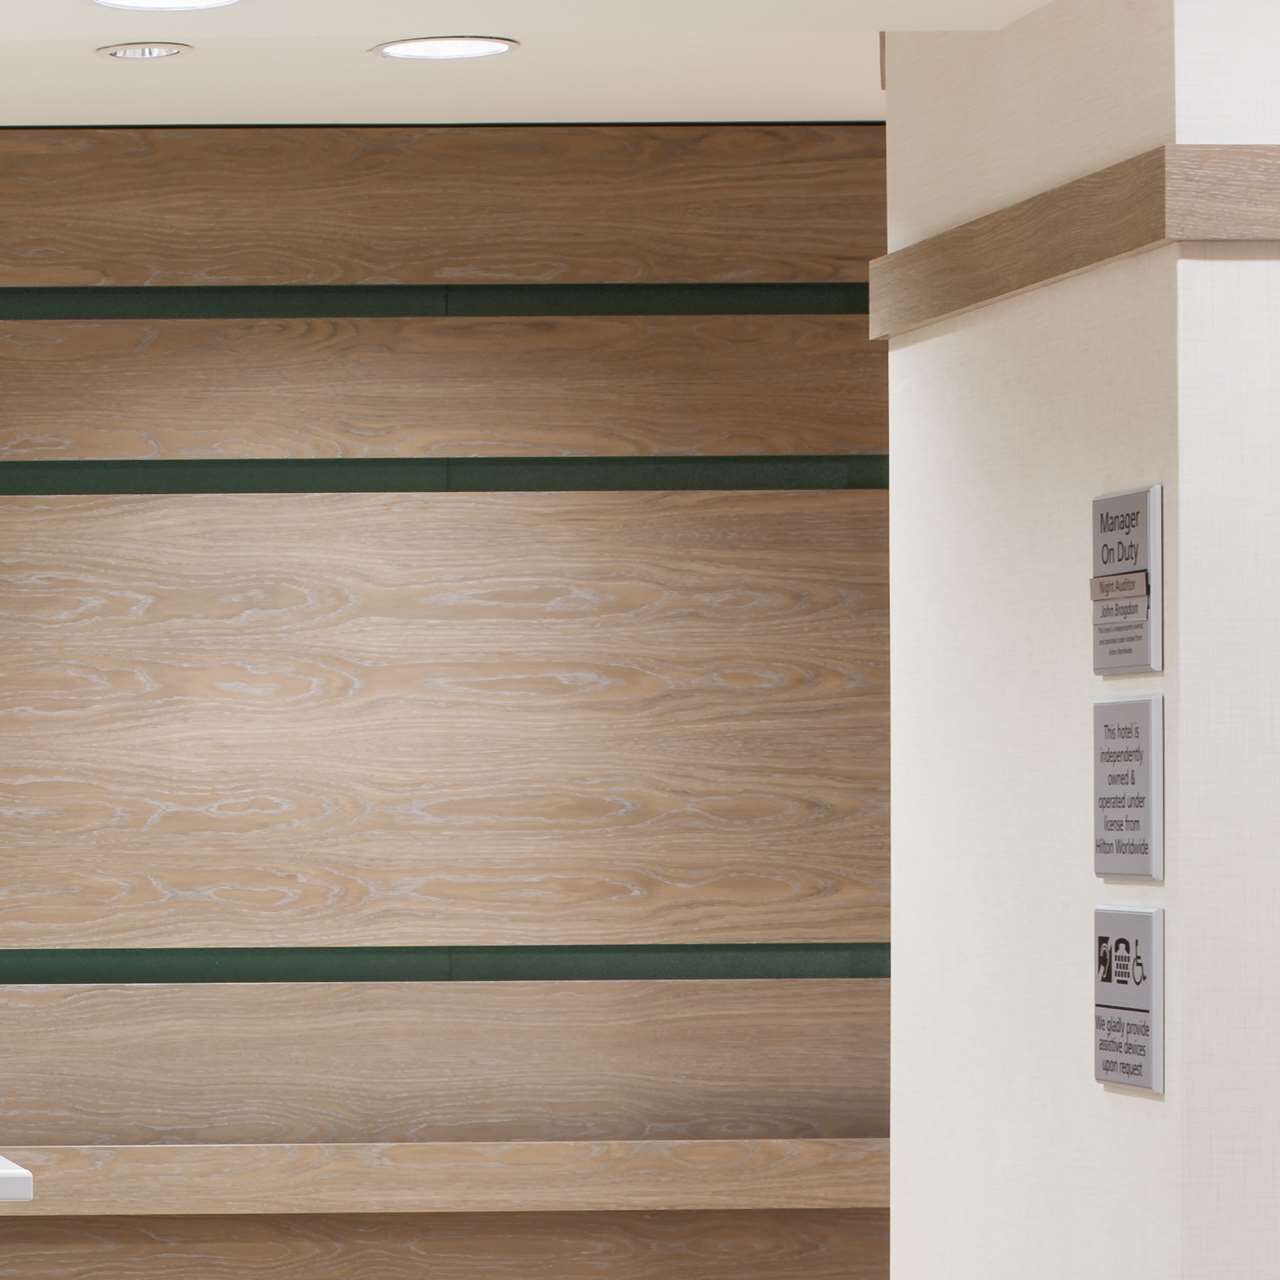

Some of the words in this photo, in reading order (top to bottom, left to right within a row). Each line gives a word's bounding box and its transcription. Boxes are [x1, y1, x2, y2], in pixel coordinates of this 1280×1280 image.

[1099, 511, 1140, 536] Manager
[1101, 543, 1115, 566] On
[1117, 539, 1139, 566] Duty
[1104, 724, 1116, 740] This
[1117, 722, 1132, 739] hotel
[1100, 745, 1144, 767] independently
[1108, 770, 1129, 785] owned
[1130, 769, 1136, 785] &
[1098, 793, 1126, 813] operated
[1127, 792, 1146, 809] under
[1104, 815, 1124, 832] license
[1125, 814, 1141, 832] from
[1114, 837, 1149, 856] Worldwide
[1106, 1016, 1125, 1038] gladly
[1126, 1019, 1150, 1042] provide
[1124, 1039, 1146, 1057] devices
[1102, 1059, 1118, 1076] upon
